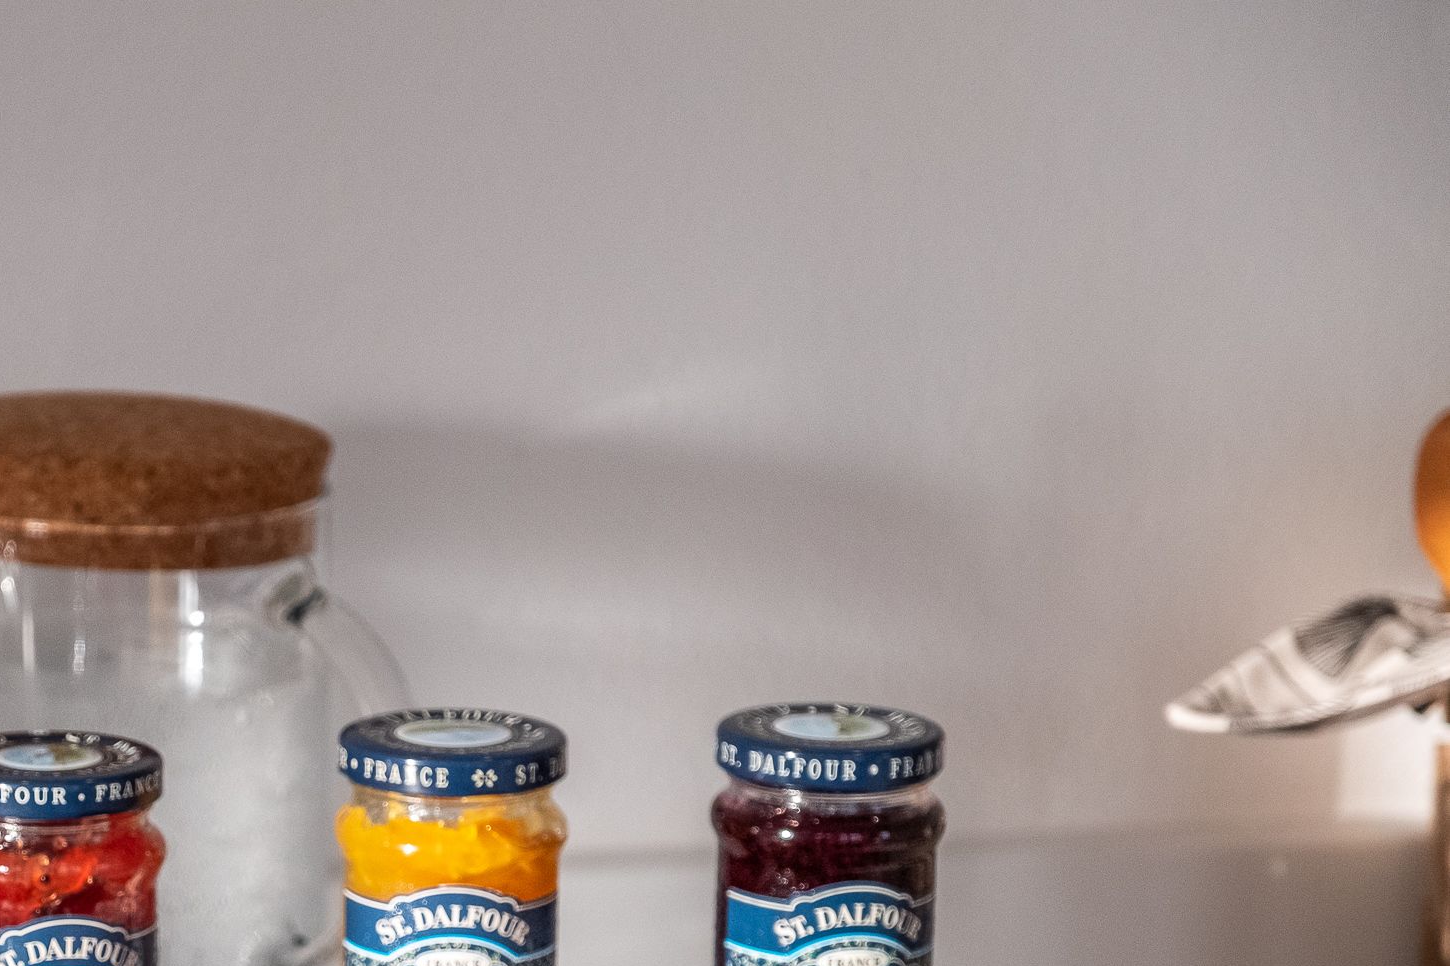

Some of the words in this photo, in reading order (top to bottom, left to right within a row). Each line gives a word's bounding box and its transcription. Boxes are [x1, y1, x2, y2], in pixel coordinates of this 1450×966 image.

[363, 757, 450, 789] FRANCE
[515, 762, 544, 785] ST.
[719, 741, 742, 768] ST.
[748, 749, 857, 782] DALFOUR
[375, 914, 413, 946] ST.
[411, 903, 530, 947] DALFOUR
[773, 915, 815, 947] ST.
[813, 902, 922, 943] DALFOUR
